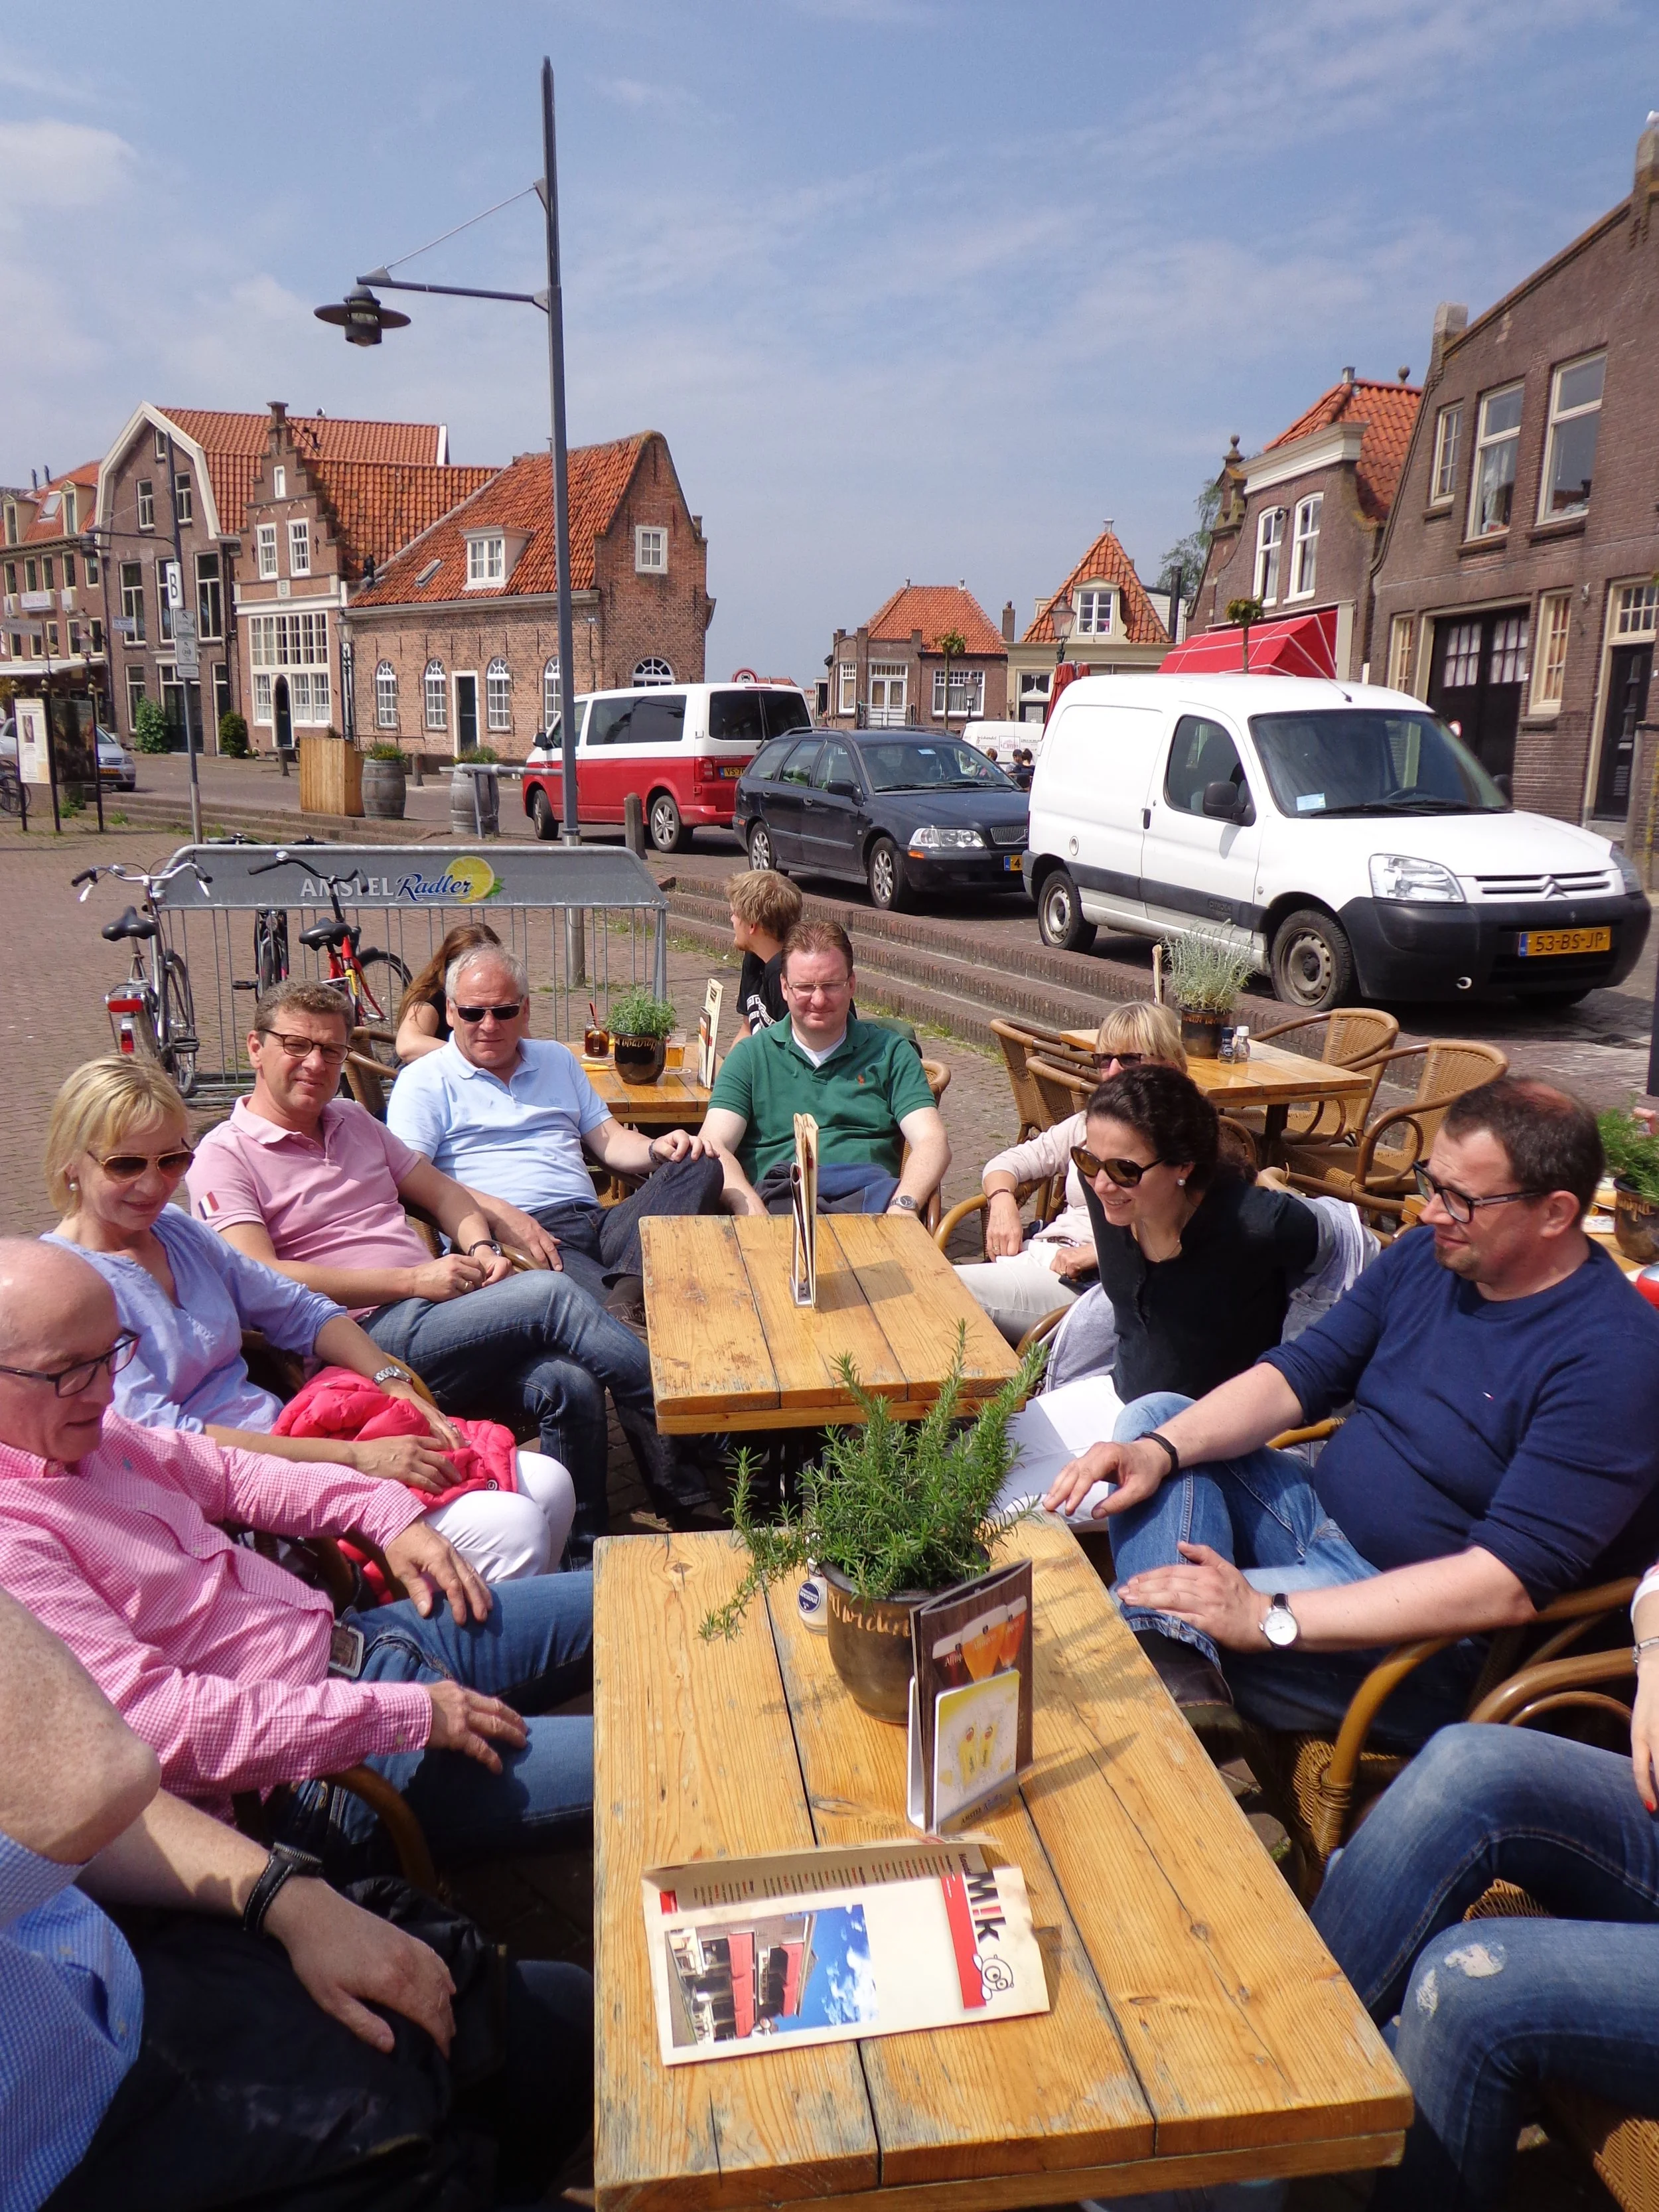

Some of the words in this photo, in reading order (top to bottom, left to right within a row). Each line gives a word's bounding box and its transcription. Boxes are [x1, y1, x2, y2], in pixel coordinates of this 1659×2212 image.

[169, 573, 178, 599] B
[299, 877, 394, 897] AMSTEL
[396, 872, 474, 902] Radler
[1535, 931, 1603, 952] 53-BS-JP
